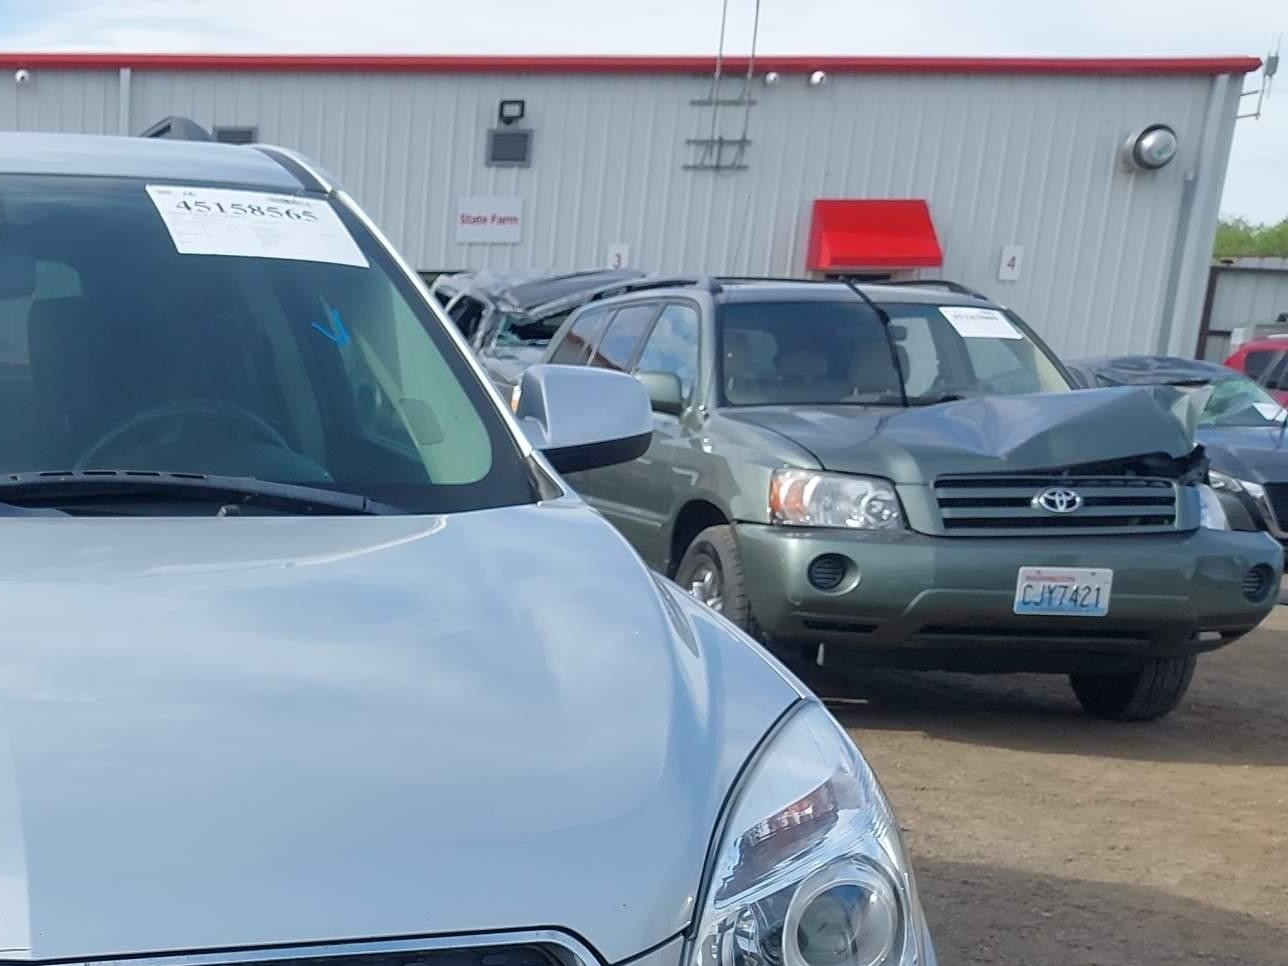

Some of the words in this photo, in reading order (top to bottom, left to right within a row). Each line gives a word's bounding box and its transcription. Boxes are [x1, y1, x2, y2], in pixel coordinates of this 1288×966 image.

[176, 199, 318, 223] 45158565
[460, 213, 487, 226] State
[490, 213, 519, 226] Farm
[612, 252, 622, 270] 3
[1007, 255, 1016, 271] 4
[1022, 584, 1101, 608] CJY7421
